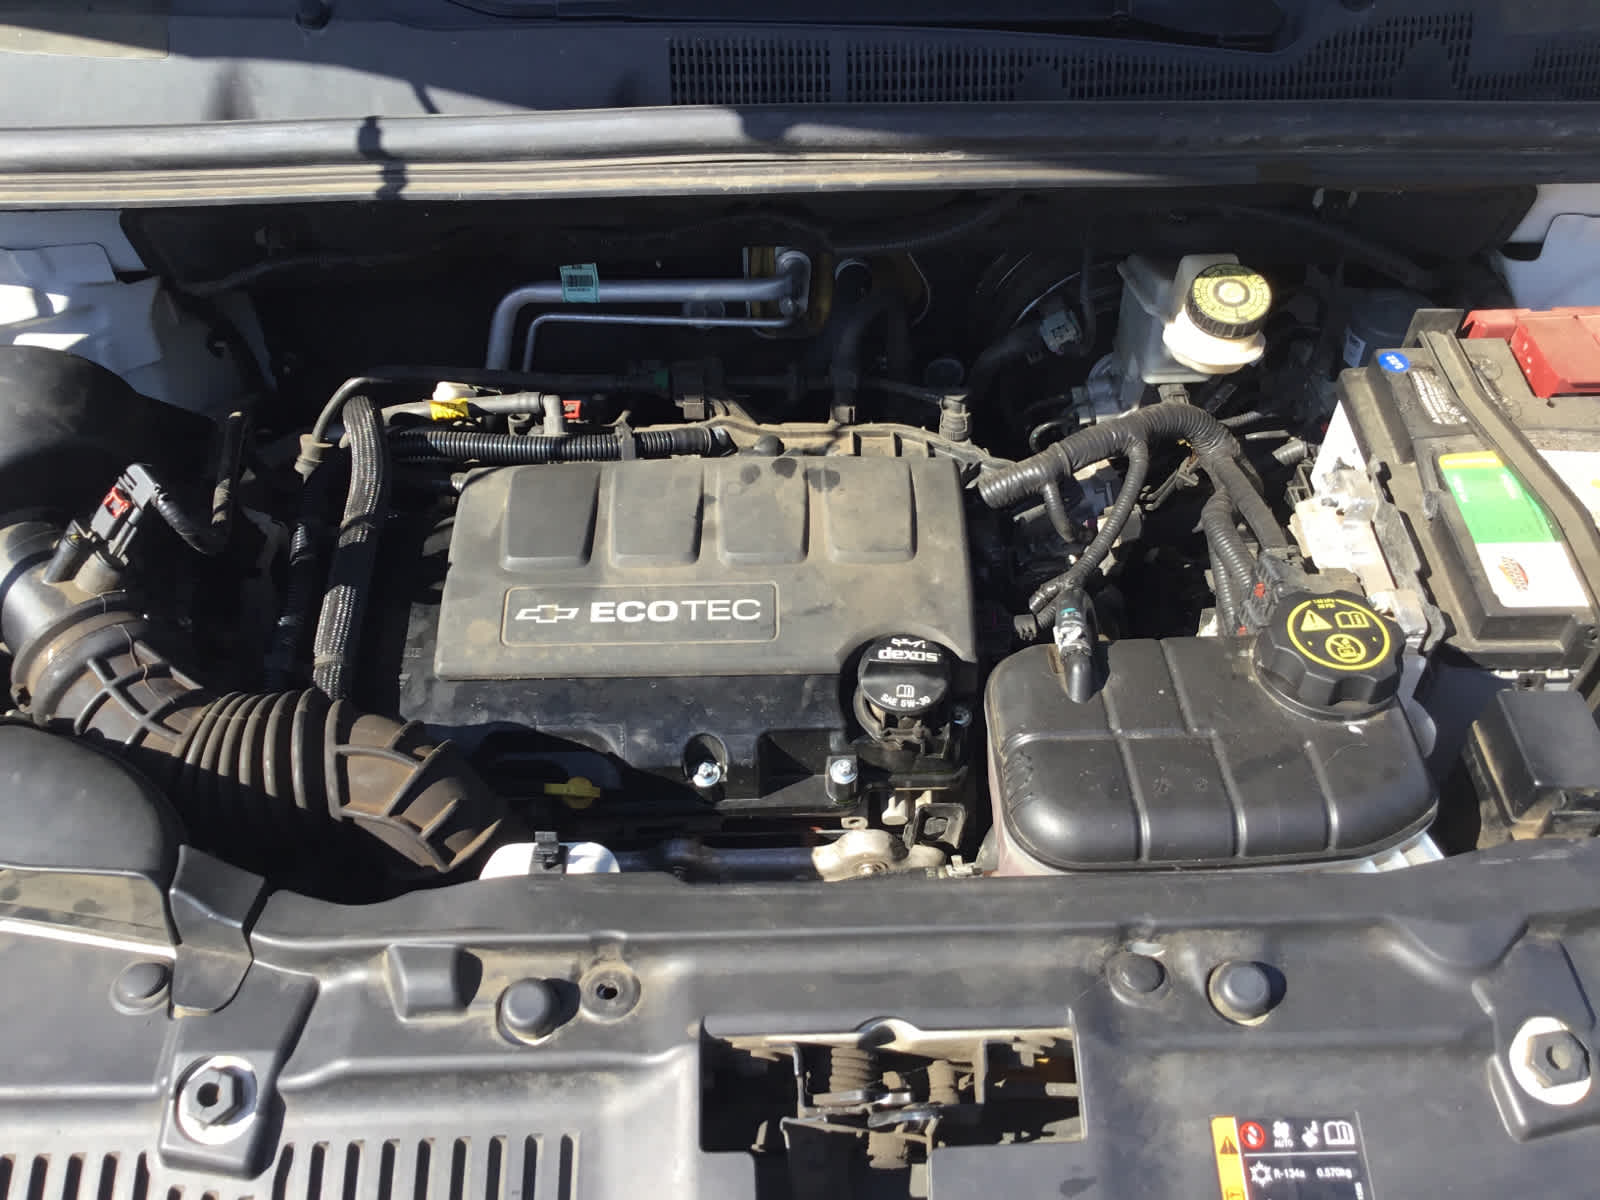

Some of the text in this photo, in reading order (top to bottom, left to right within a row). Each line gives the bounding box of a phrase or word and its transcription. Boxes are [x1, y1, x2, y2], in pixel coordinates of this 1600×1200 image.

[590, 599, 761, 622] ECOTEC
[878, 647, 938, 662] dexos
[881, 693, 931, 708] SAE 5W-30
